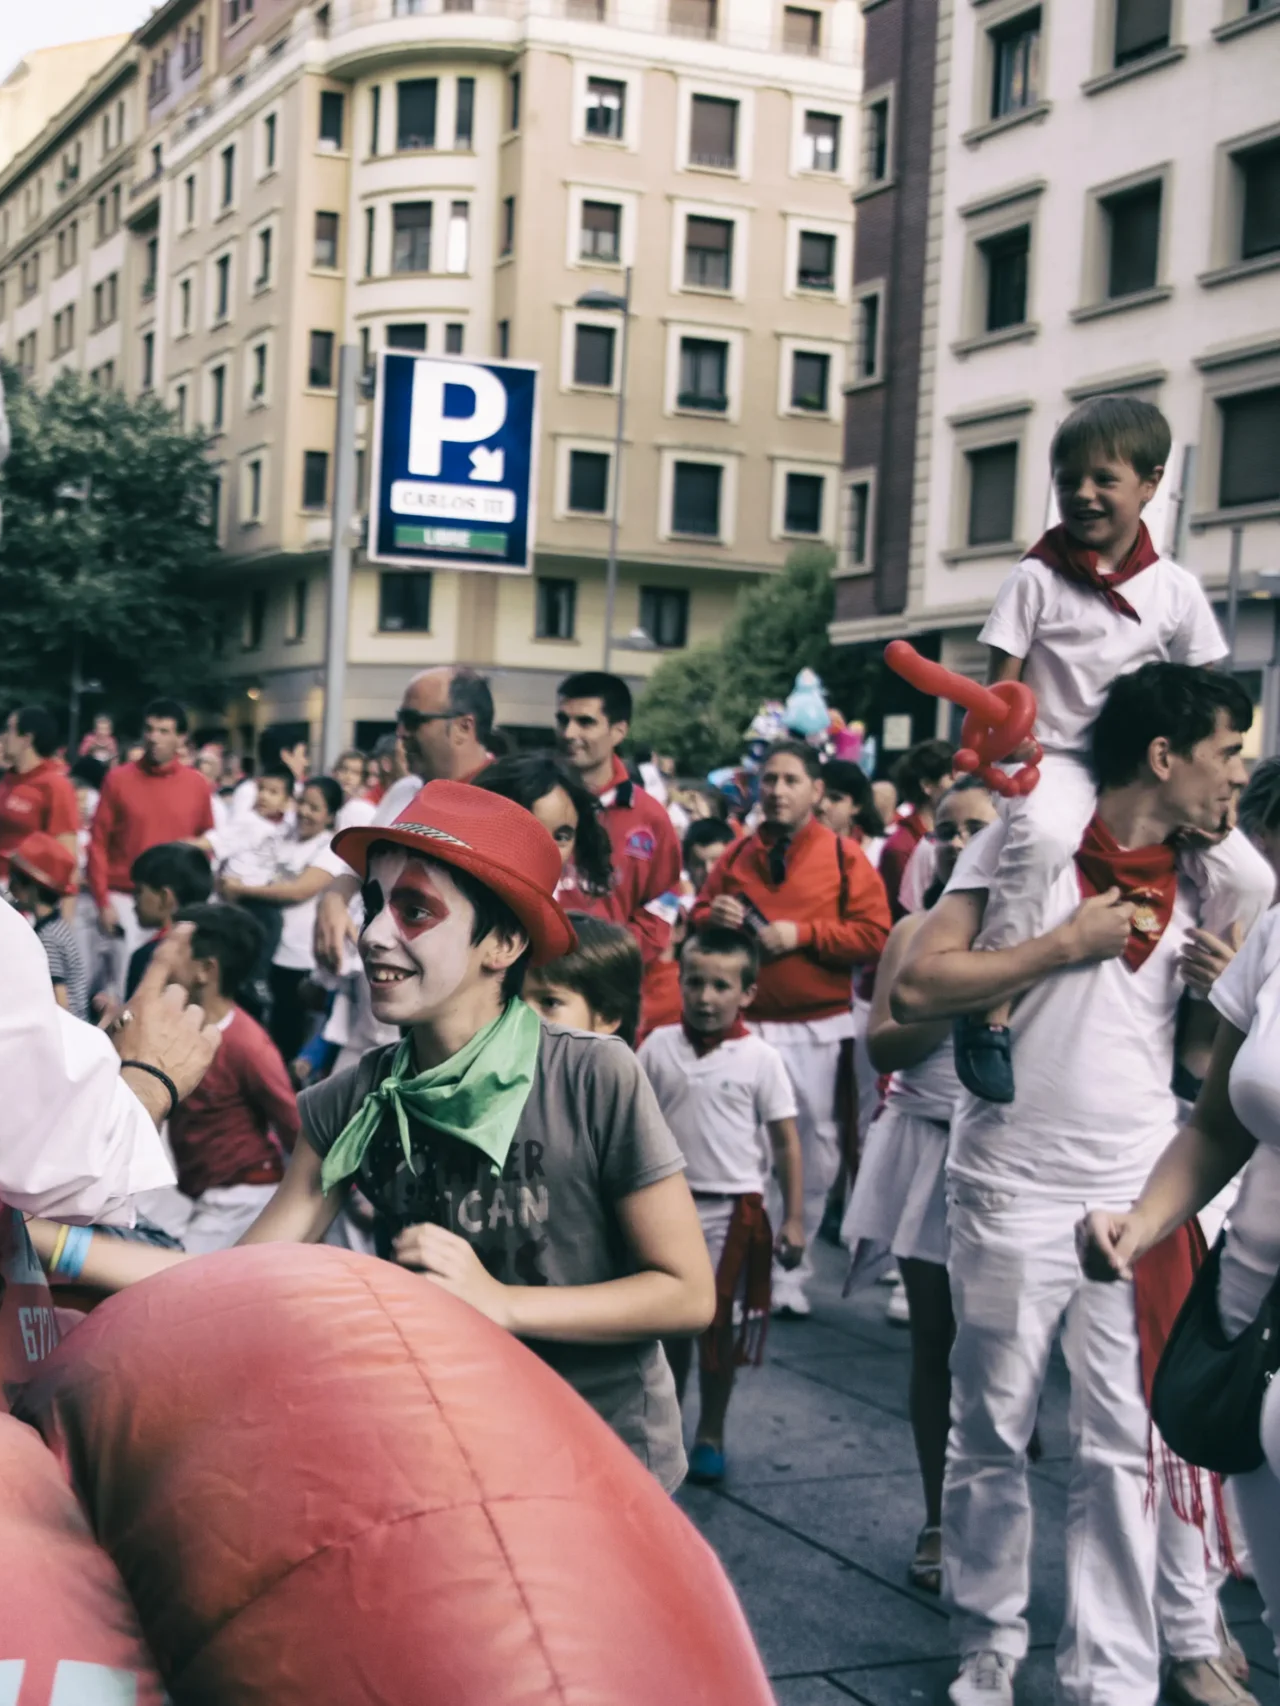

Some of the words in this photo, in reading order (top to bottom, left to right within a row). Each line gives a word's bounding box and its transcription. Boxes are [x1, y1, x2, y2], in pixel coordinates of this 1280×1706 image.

[407, 358, 508, 477] P
[402, 491, 476, 511] CARLOS
[483, 498, 505, 515] III
